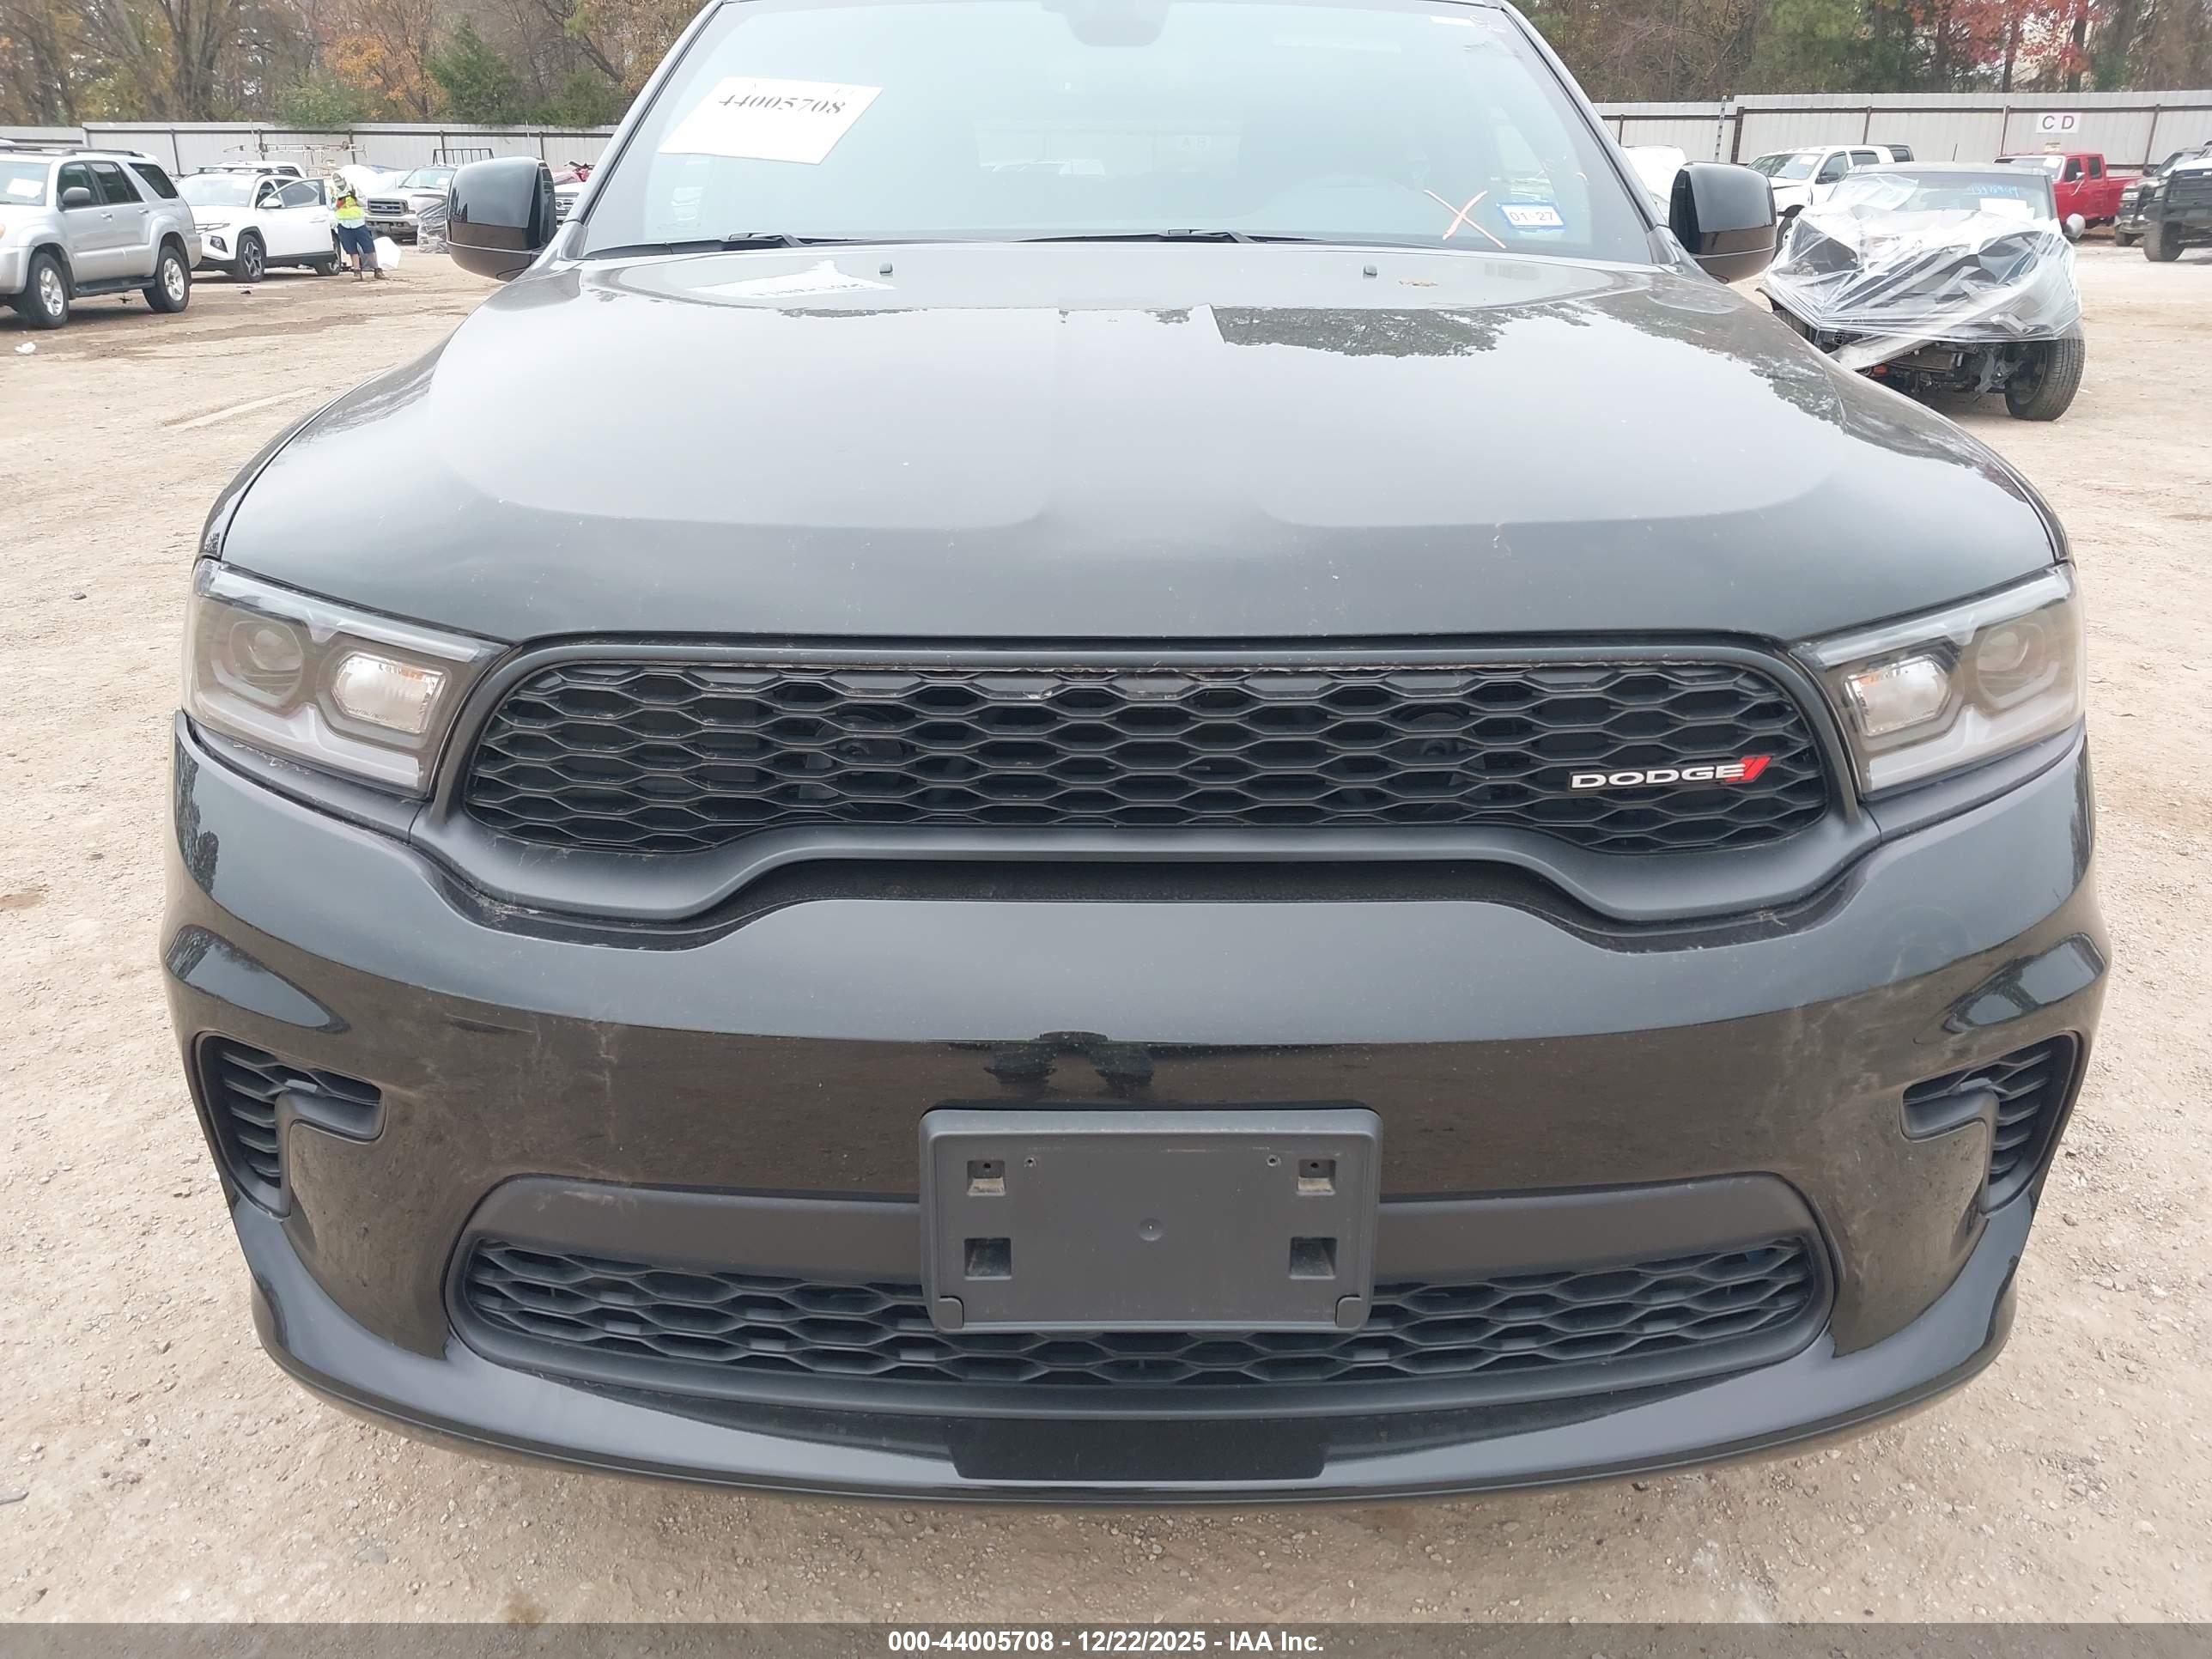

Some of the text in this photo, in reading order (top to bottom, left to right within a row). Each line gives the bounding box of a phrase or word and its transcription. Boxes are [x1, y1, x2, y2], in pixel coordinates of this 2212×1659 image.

[718, 94, 846, 114] 44005708
[2042, 115, 2075, 130] C D
[1571, 763, 1746, 788] DODGE
